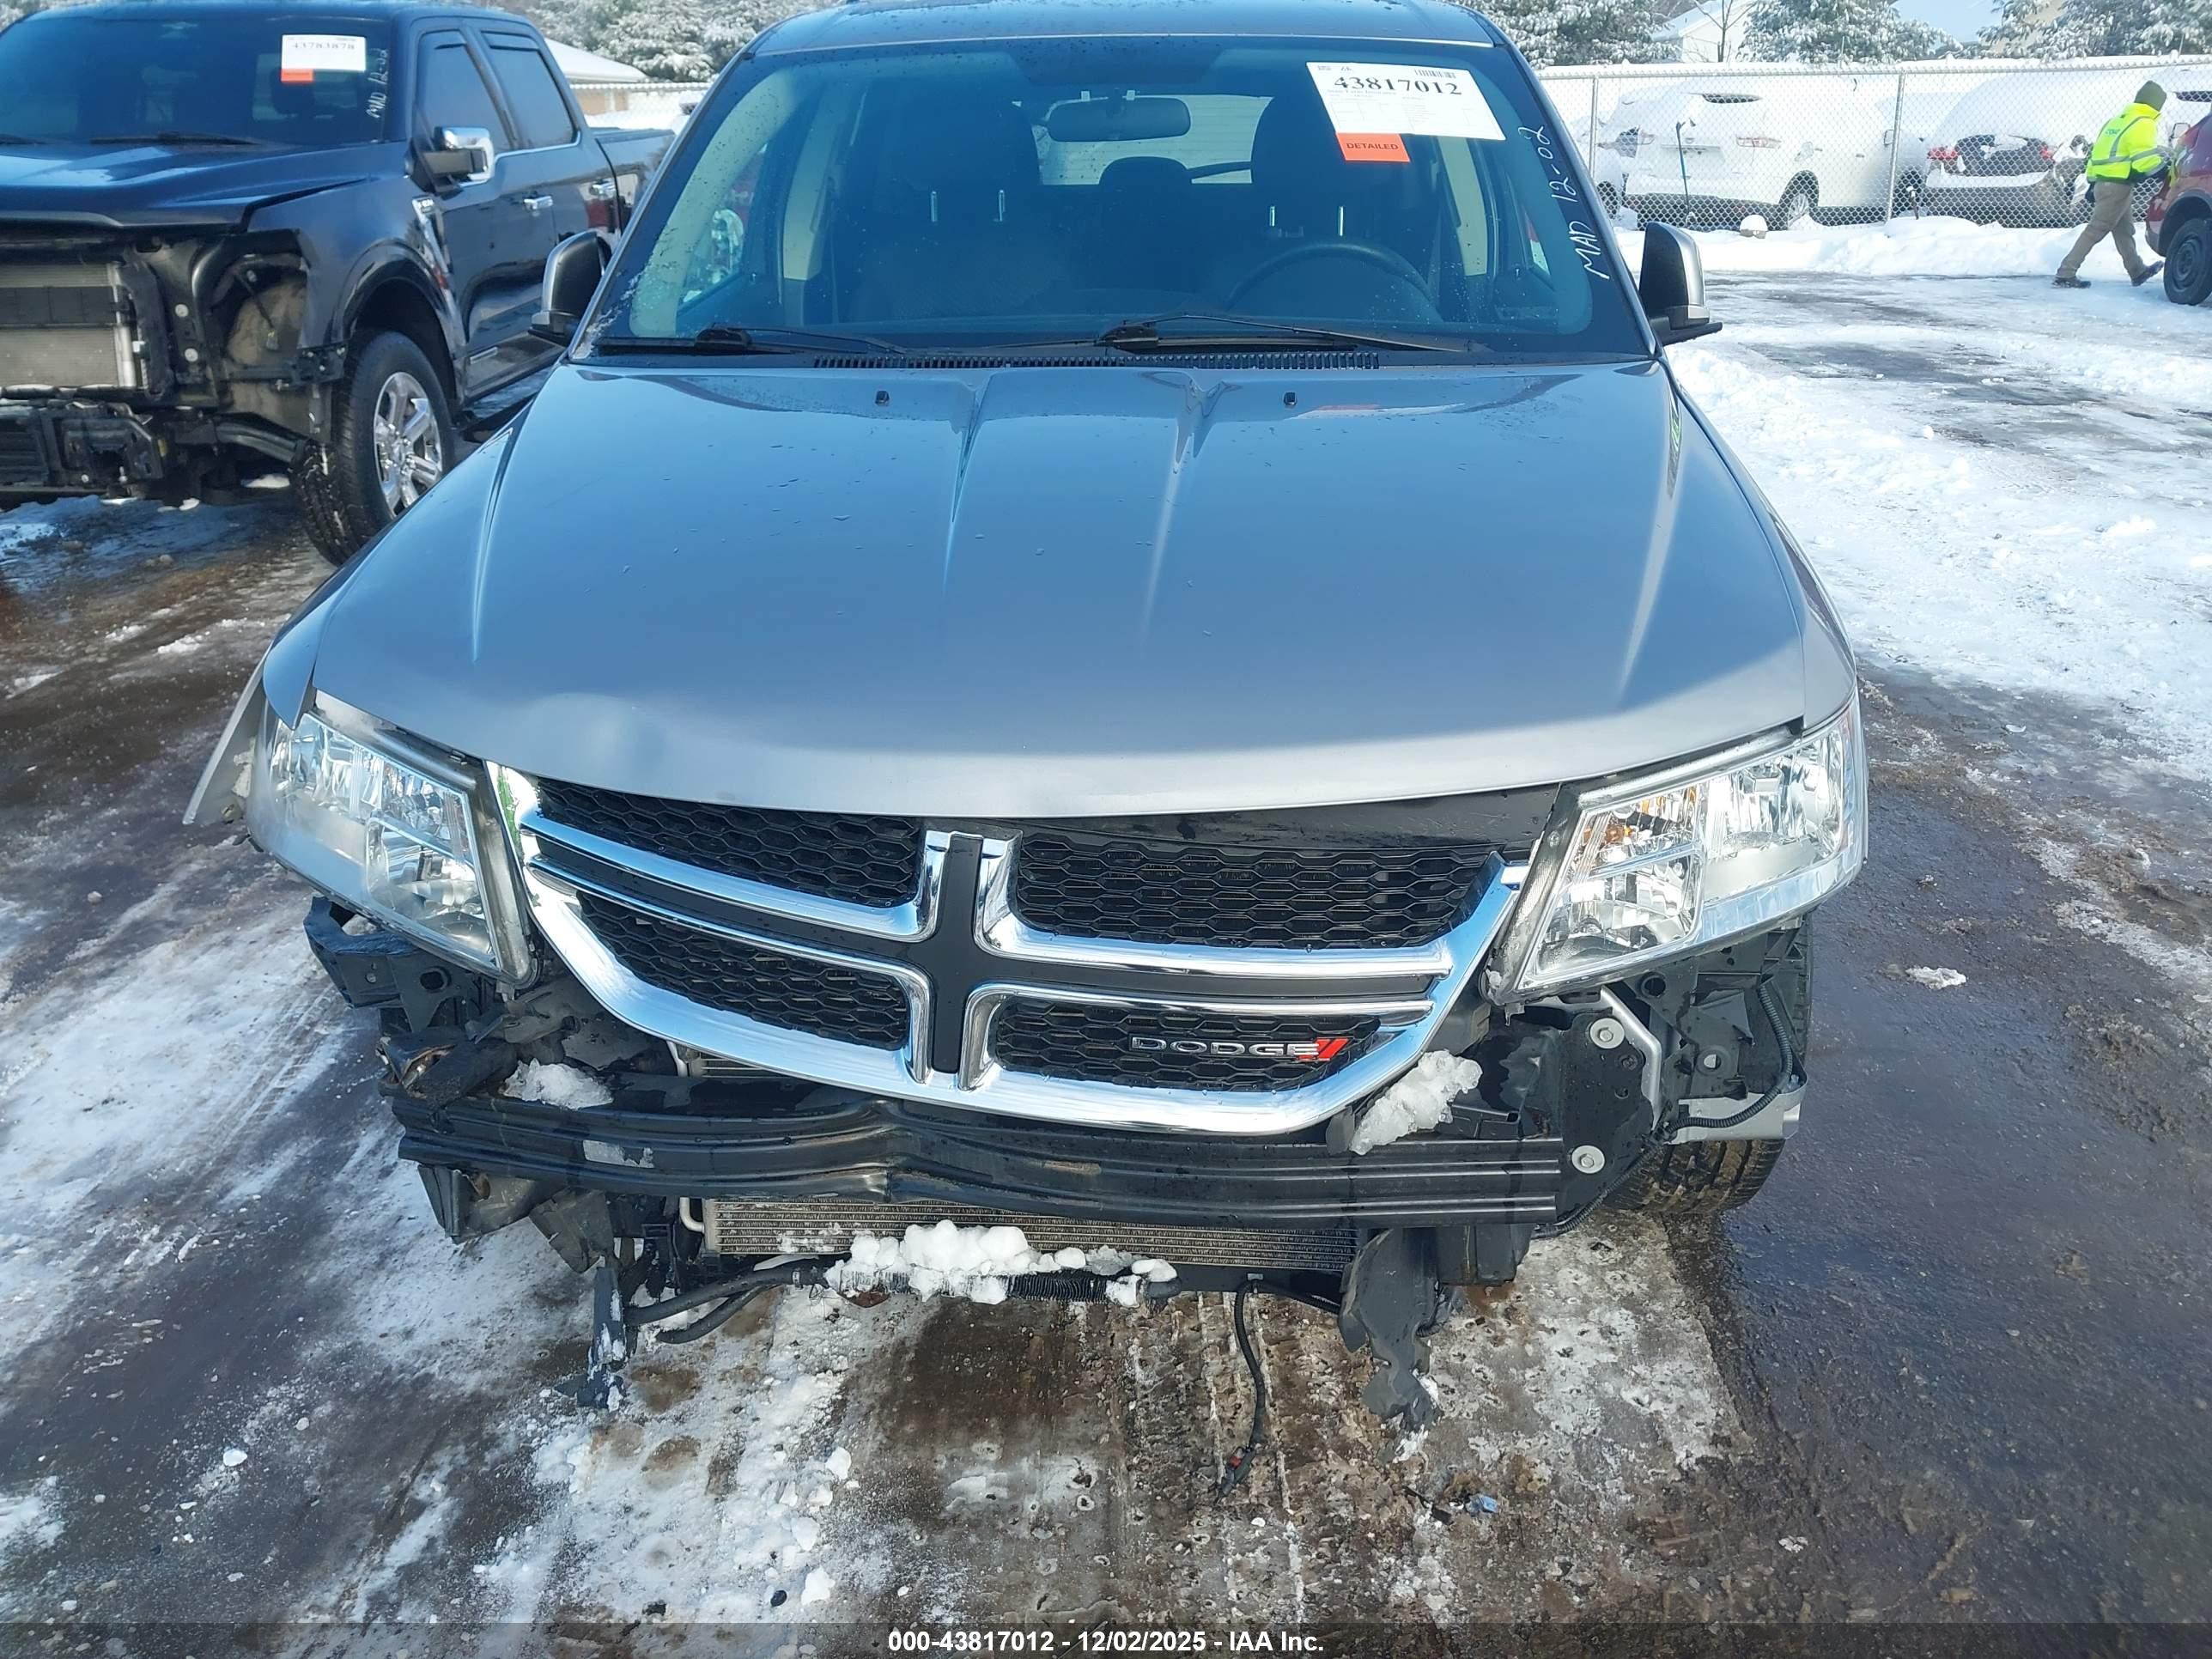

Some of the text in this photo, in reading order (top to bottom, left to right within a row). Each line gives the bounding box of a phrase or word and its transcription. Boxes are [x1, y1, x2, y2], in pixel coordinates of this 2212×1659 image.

[1334, 76, 1462, 95] 43817012
[1346, 142, 1399, 151] DETAILED
[1517, 125, 1610, 280] MAD 12-02
[1132, 1036, 1320, 1057] DODGE
